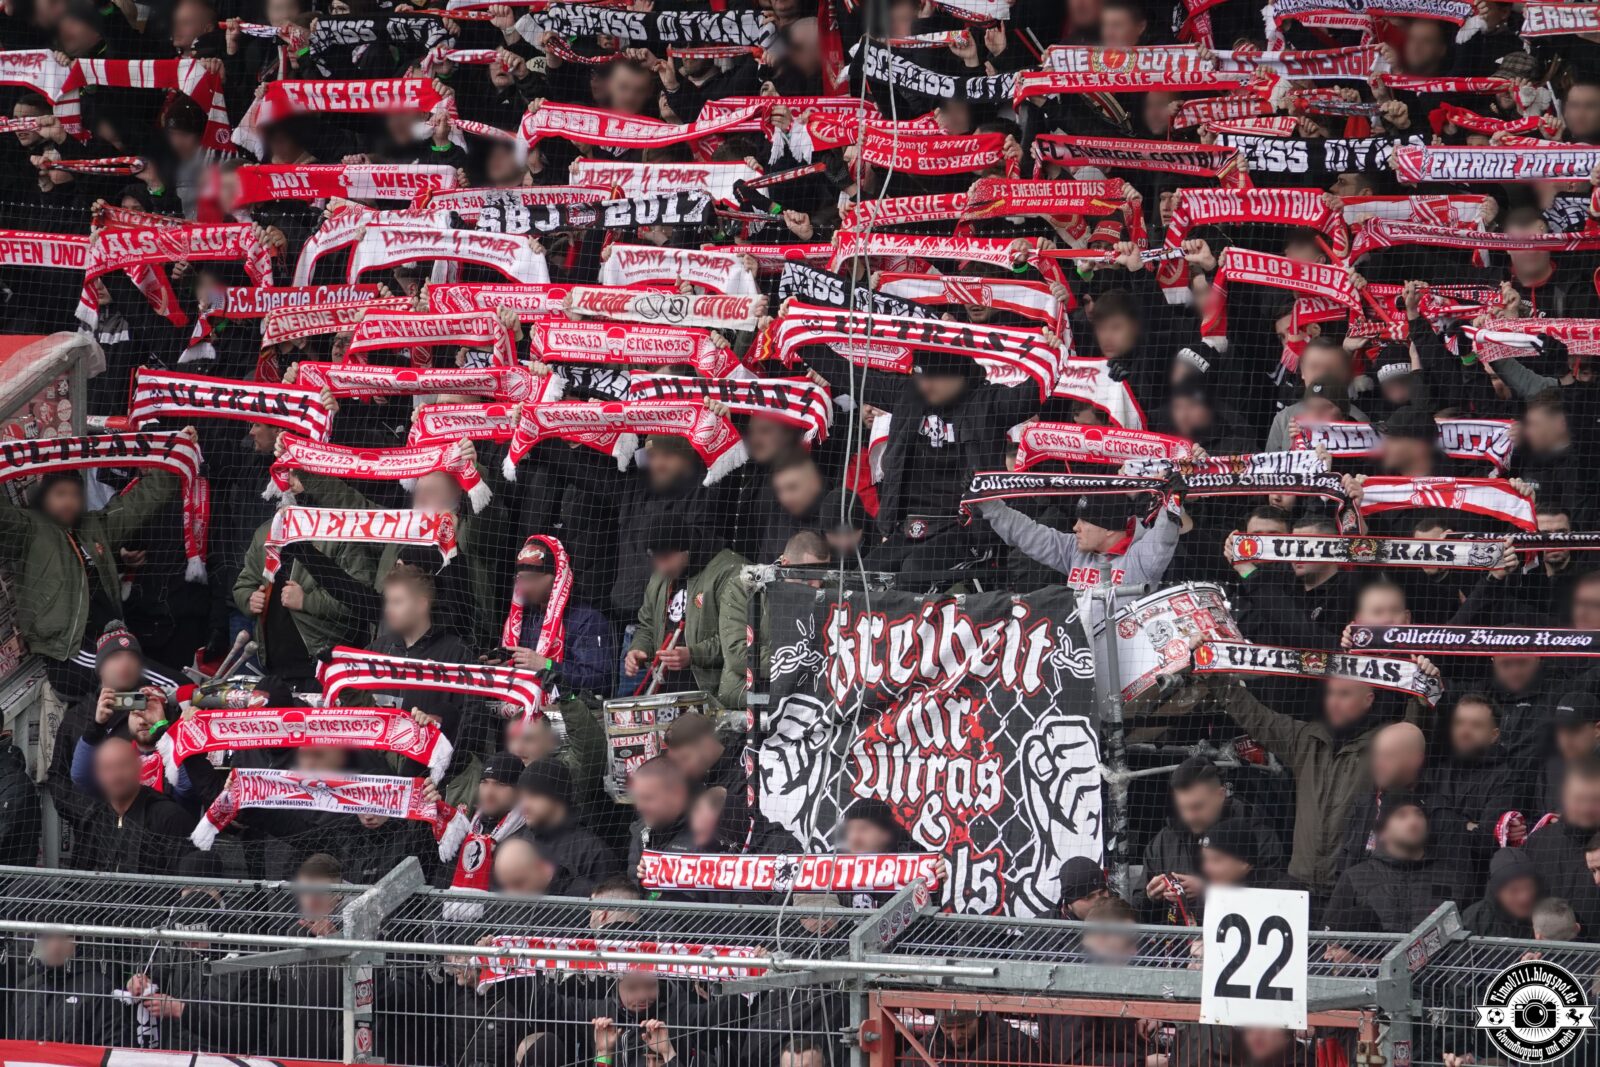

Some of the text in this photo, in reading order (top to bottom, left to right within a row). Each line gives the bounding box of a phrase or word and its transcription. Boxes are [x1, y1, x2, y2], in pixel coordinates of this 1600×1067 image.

[282, 79, 423, 112] ENERGIE
[862, 149, 999, 171] ENERGIE COTTB
[1431, 151, 1517, 180] ENERGIE
[270, 172, 310, 189] ROT
[372, 173, 443, 190] WEISS
[657, 169, 710, 187] POWER
[1012, 182, 1053, 197] ENERGIE
[1055, 182, 1106, 197] COTTBUS
[271, 190, 290, 198] WIE
[293, 189, 319, 198] BLUT
[399, 190, 415, 198] SC
[859, 192, 945, 222] ENERGIE
[1250, 188, 1326, 222] COTTBUS
[601, 190, 710, 227] 2017
[0, 242, 86, 267] PFEN UND
[468, 233, 521, 259] POWER
[687, 252, 736, 276] POWER
[577, 290, 753, 321] ENERGIE COTTBUS
[268, 310, 336, 338] ENERGIE
[834, 314, 1009, 353] ULTRAS
[626, 335, 691, 353] ENERGIE
[167, 381, 292, 417] ULTRAS
[651, 376, 792, 411] ULTRAS
[626, 409, 694, 425] ENERGIE
[2, 432, 154, 468] ULTRAS
[1105, 440, 1164, 458] ENERGIE
[1383, 627, 1593, 646] Collettivo Bianco Rosso
[366, 656, 497, 690] ULTRAS
[218, 718, 380, 734] BESKID ENERGIE
[241, 775, 406, 810] RADIKALE MENTALITÄT
[645, 854, 938, 890] ENERGIE COTTBUS
[1214, 912, 1294, 1001] 22
